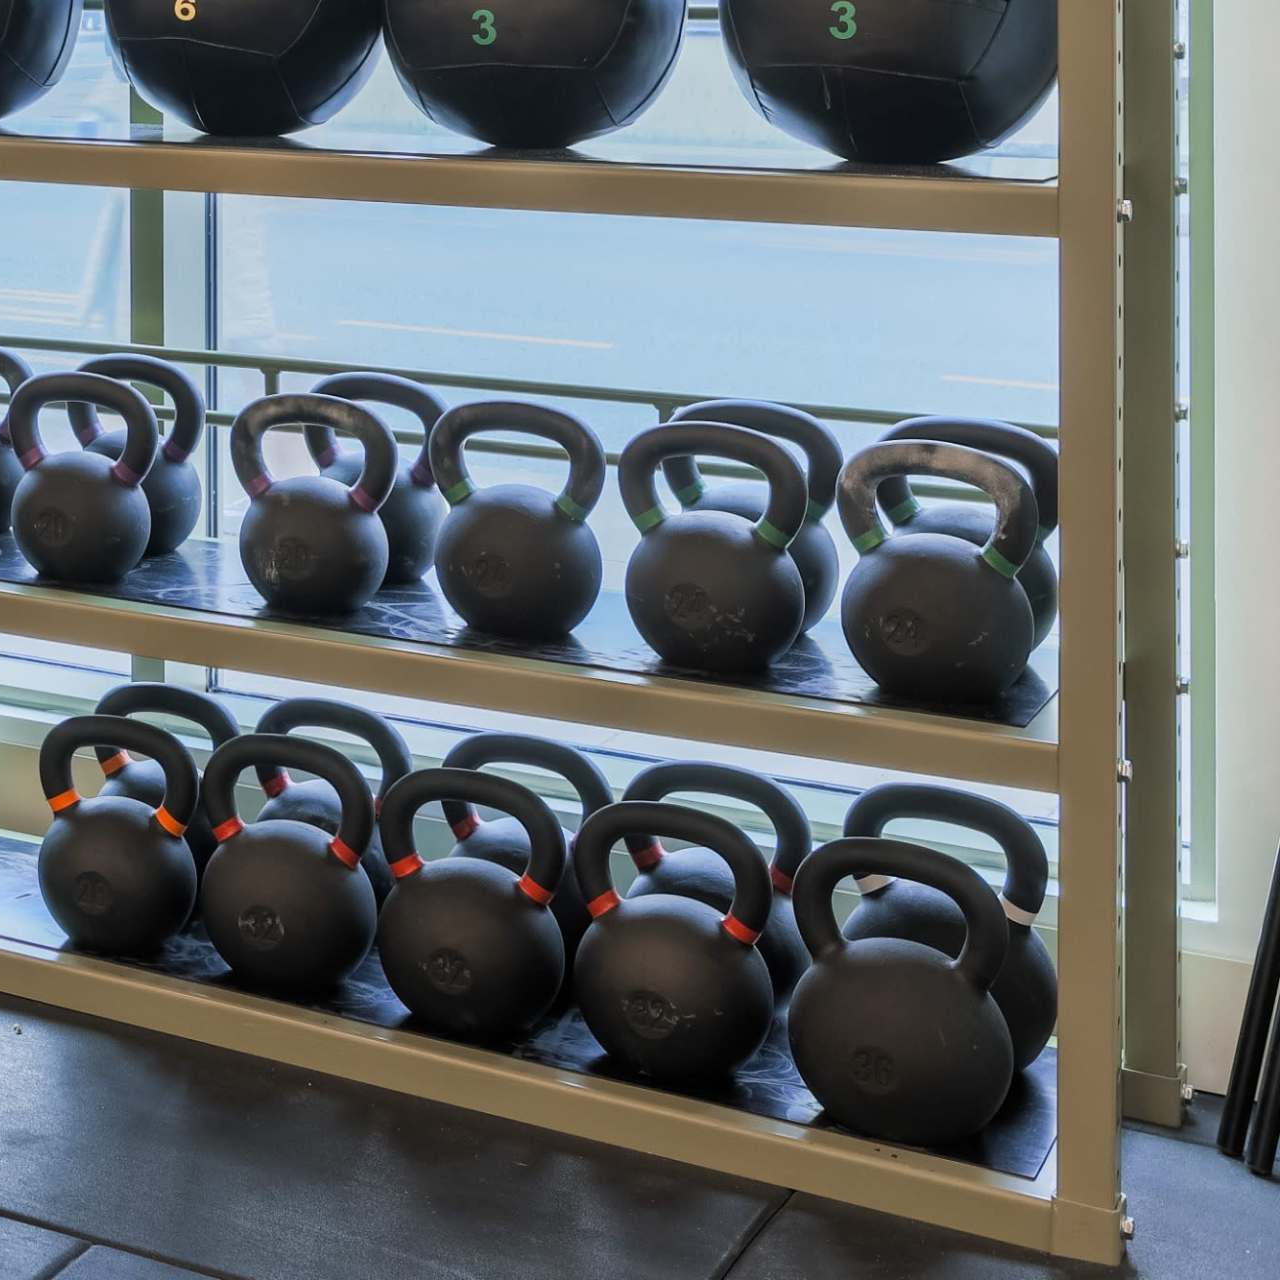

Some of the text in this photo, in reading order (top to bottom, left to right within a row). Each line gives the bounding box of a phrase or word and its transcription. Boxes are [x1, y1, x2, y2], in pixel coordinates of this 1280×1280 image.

[472, 10, 496, 44] 3
[830, 1, 856, 39] 3
[853, 1050, 894, 1087] 36
